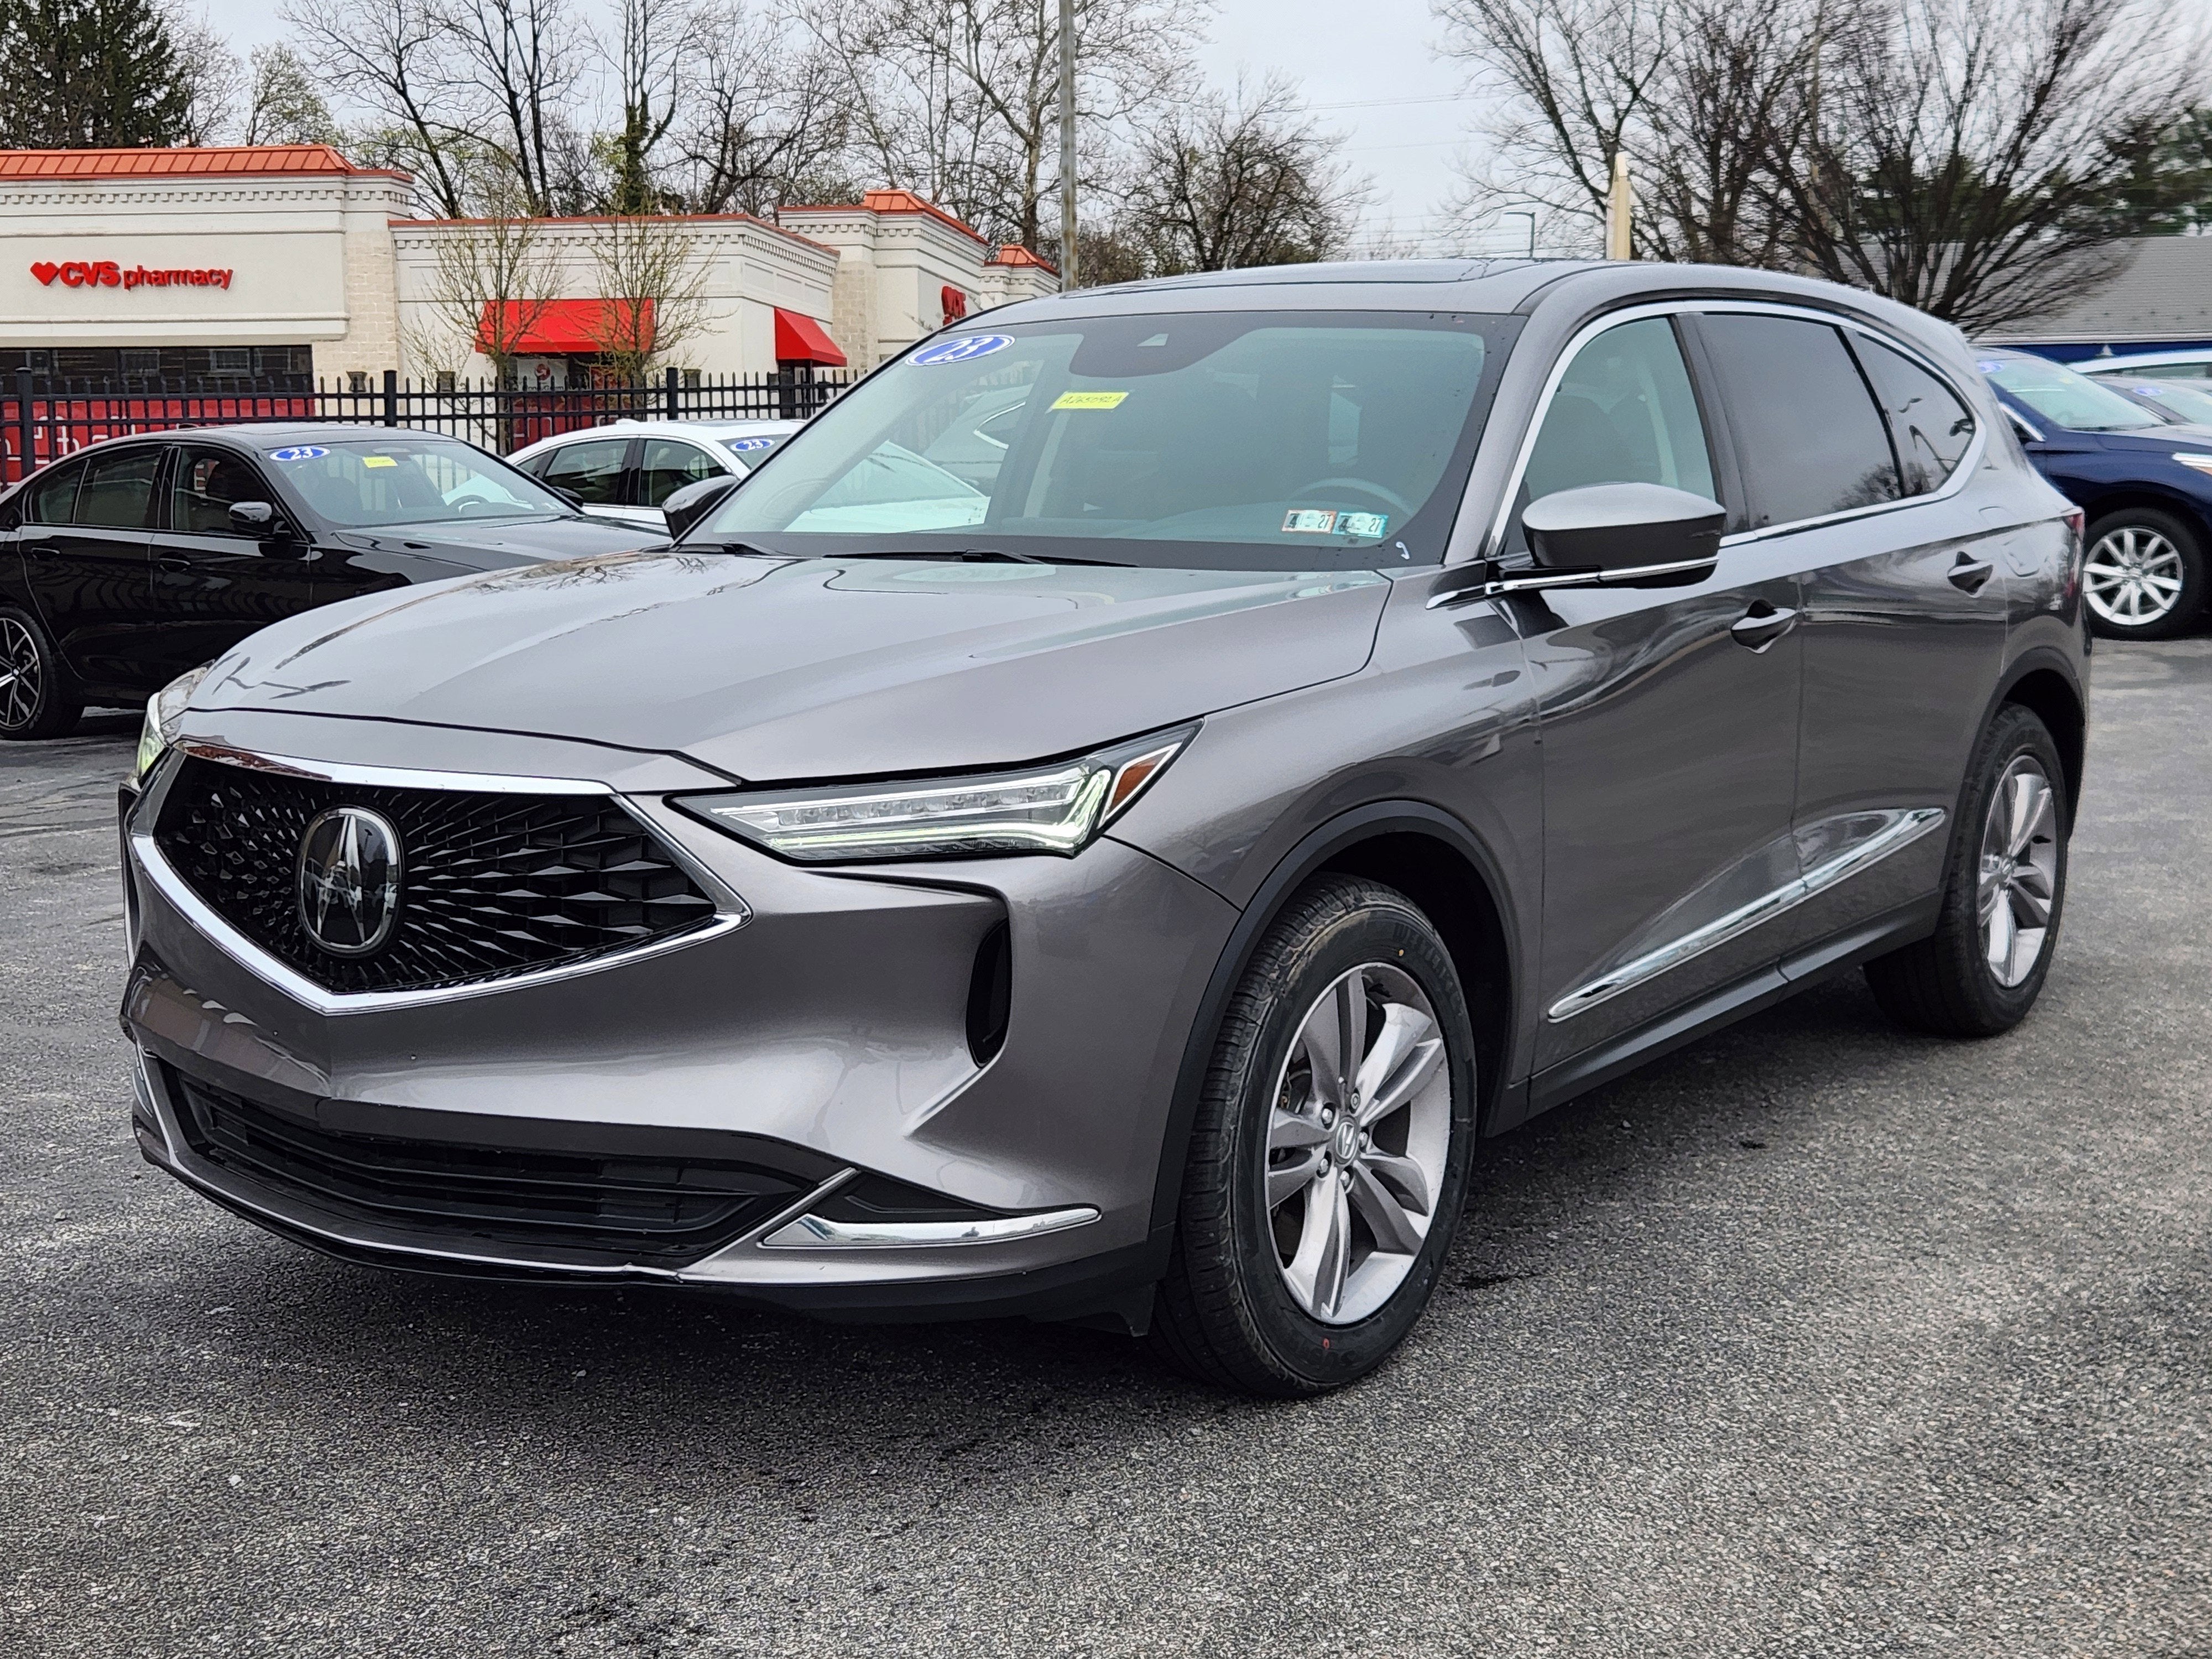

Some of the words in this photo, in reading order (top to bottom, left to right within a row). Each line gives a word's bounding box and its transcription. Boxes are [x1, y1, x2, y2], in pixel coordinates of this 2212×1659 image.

[59, 261, 121, 286] CVS
[123, 265, 233, 290] pharmacy
[923, 337, 994, 363] 23
[743, 439, 764, 450] 23
[288, 447, 314, 460] 23
[1317, 514, 1332, 529] 27
[1368, 517, 1382, 533] 27
